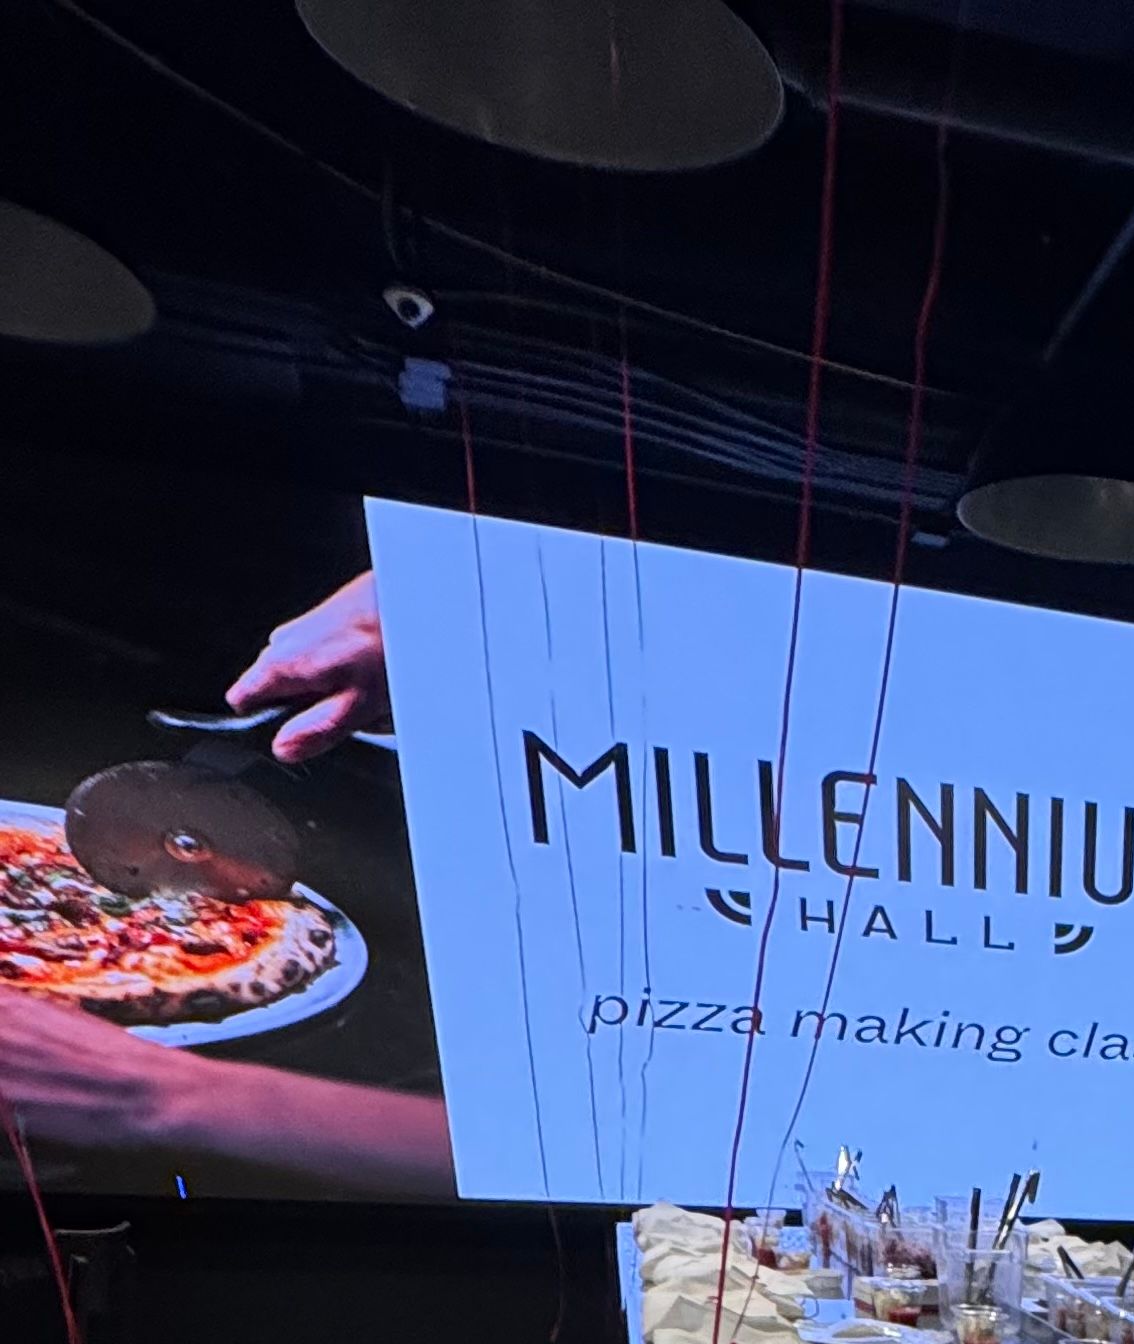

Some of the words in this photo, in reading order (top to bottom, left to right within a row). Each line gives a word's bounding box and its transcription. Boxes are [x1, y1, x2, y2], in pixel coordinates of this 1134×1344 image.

[798, 896, 1015, 951] HALL
[585, 987, 766, 1036] pizza
[789, 1006, 1030, 1064] making
